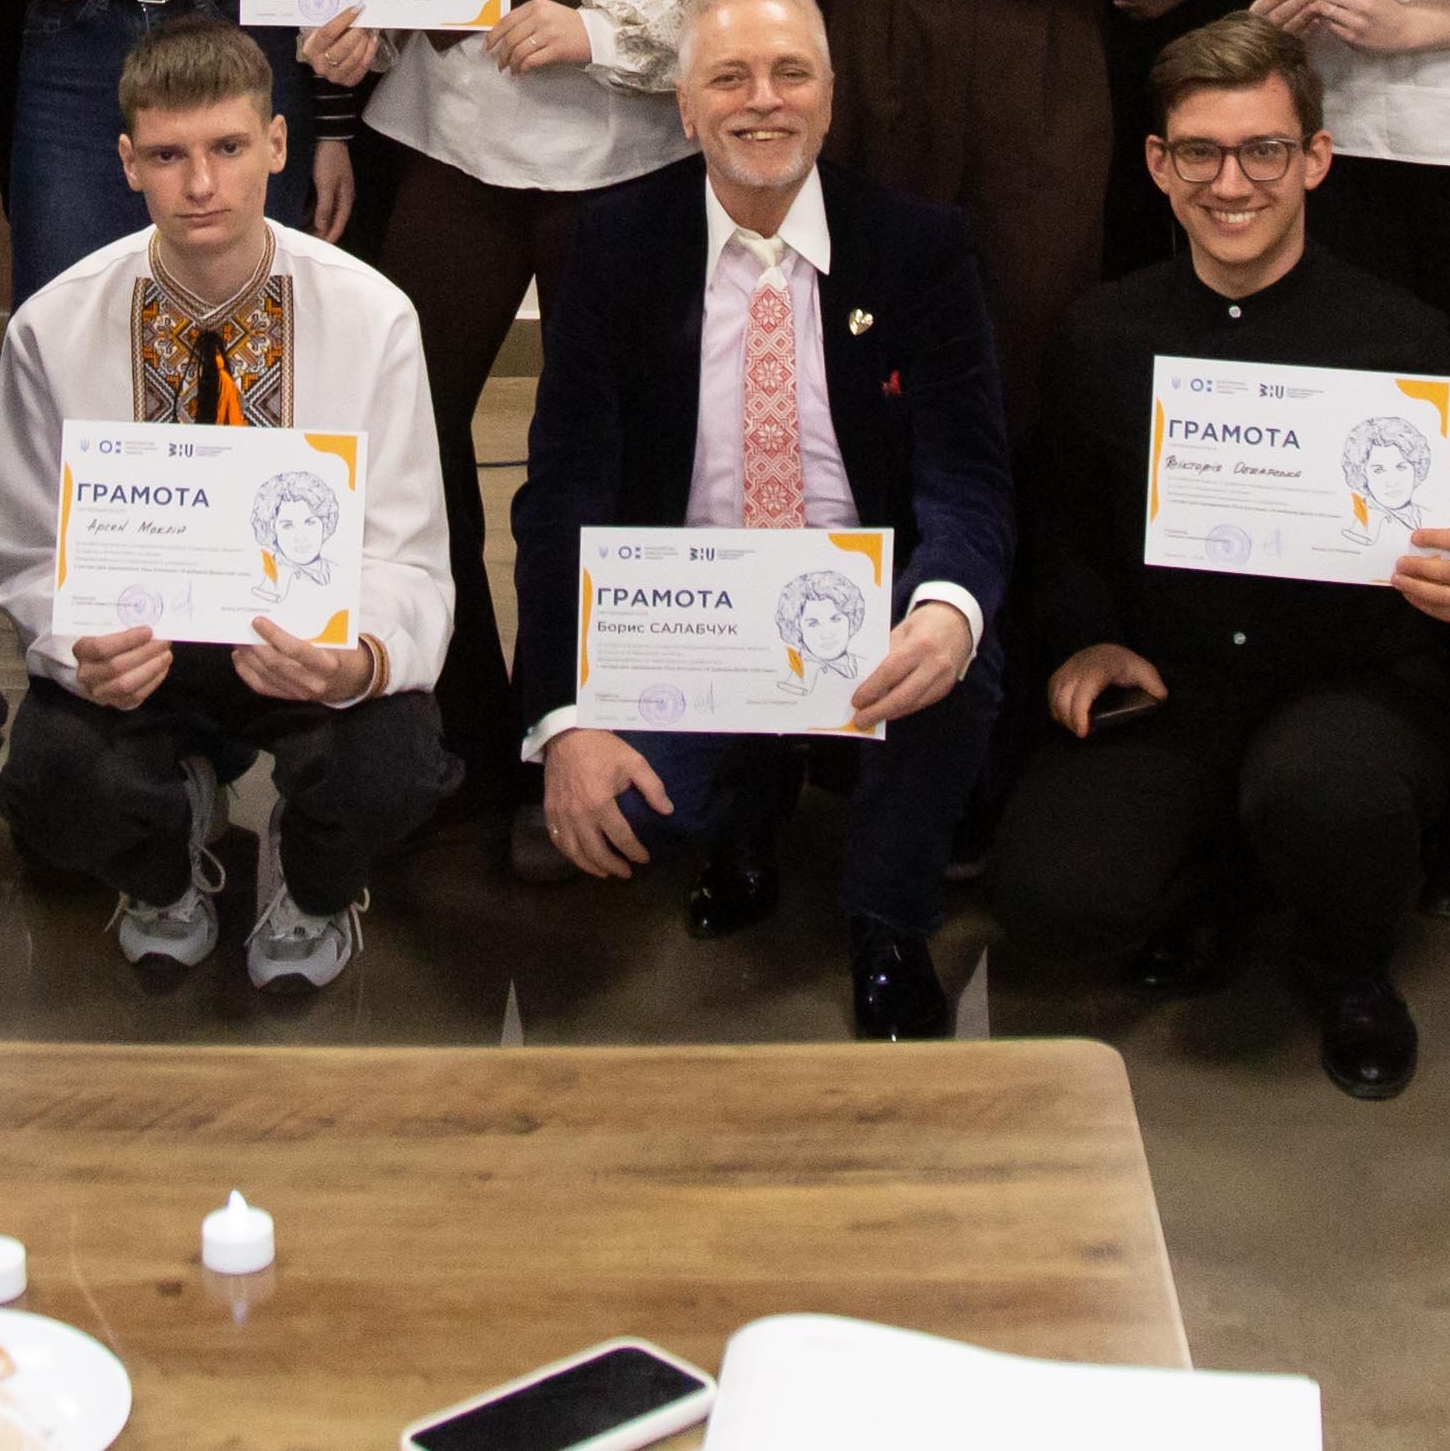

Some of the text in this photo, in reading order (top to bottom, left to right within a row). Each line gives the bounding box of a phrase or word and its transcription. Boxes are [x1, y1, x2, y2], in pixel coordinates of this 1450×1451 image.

[1169, 419, 1300, 449] ГРАМОТА
[77, 482, 210, 508] ГРАМОТА
[597, 588, 734, 609] ГРАМОТА
[597, 621, 738, 636] Борис САЛАБЧУК
